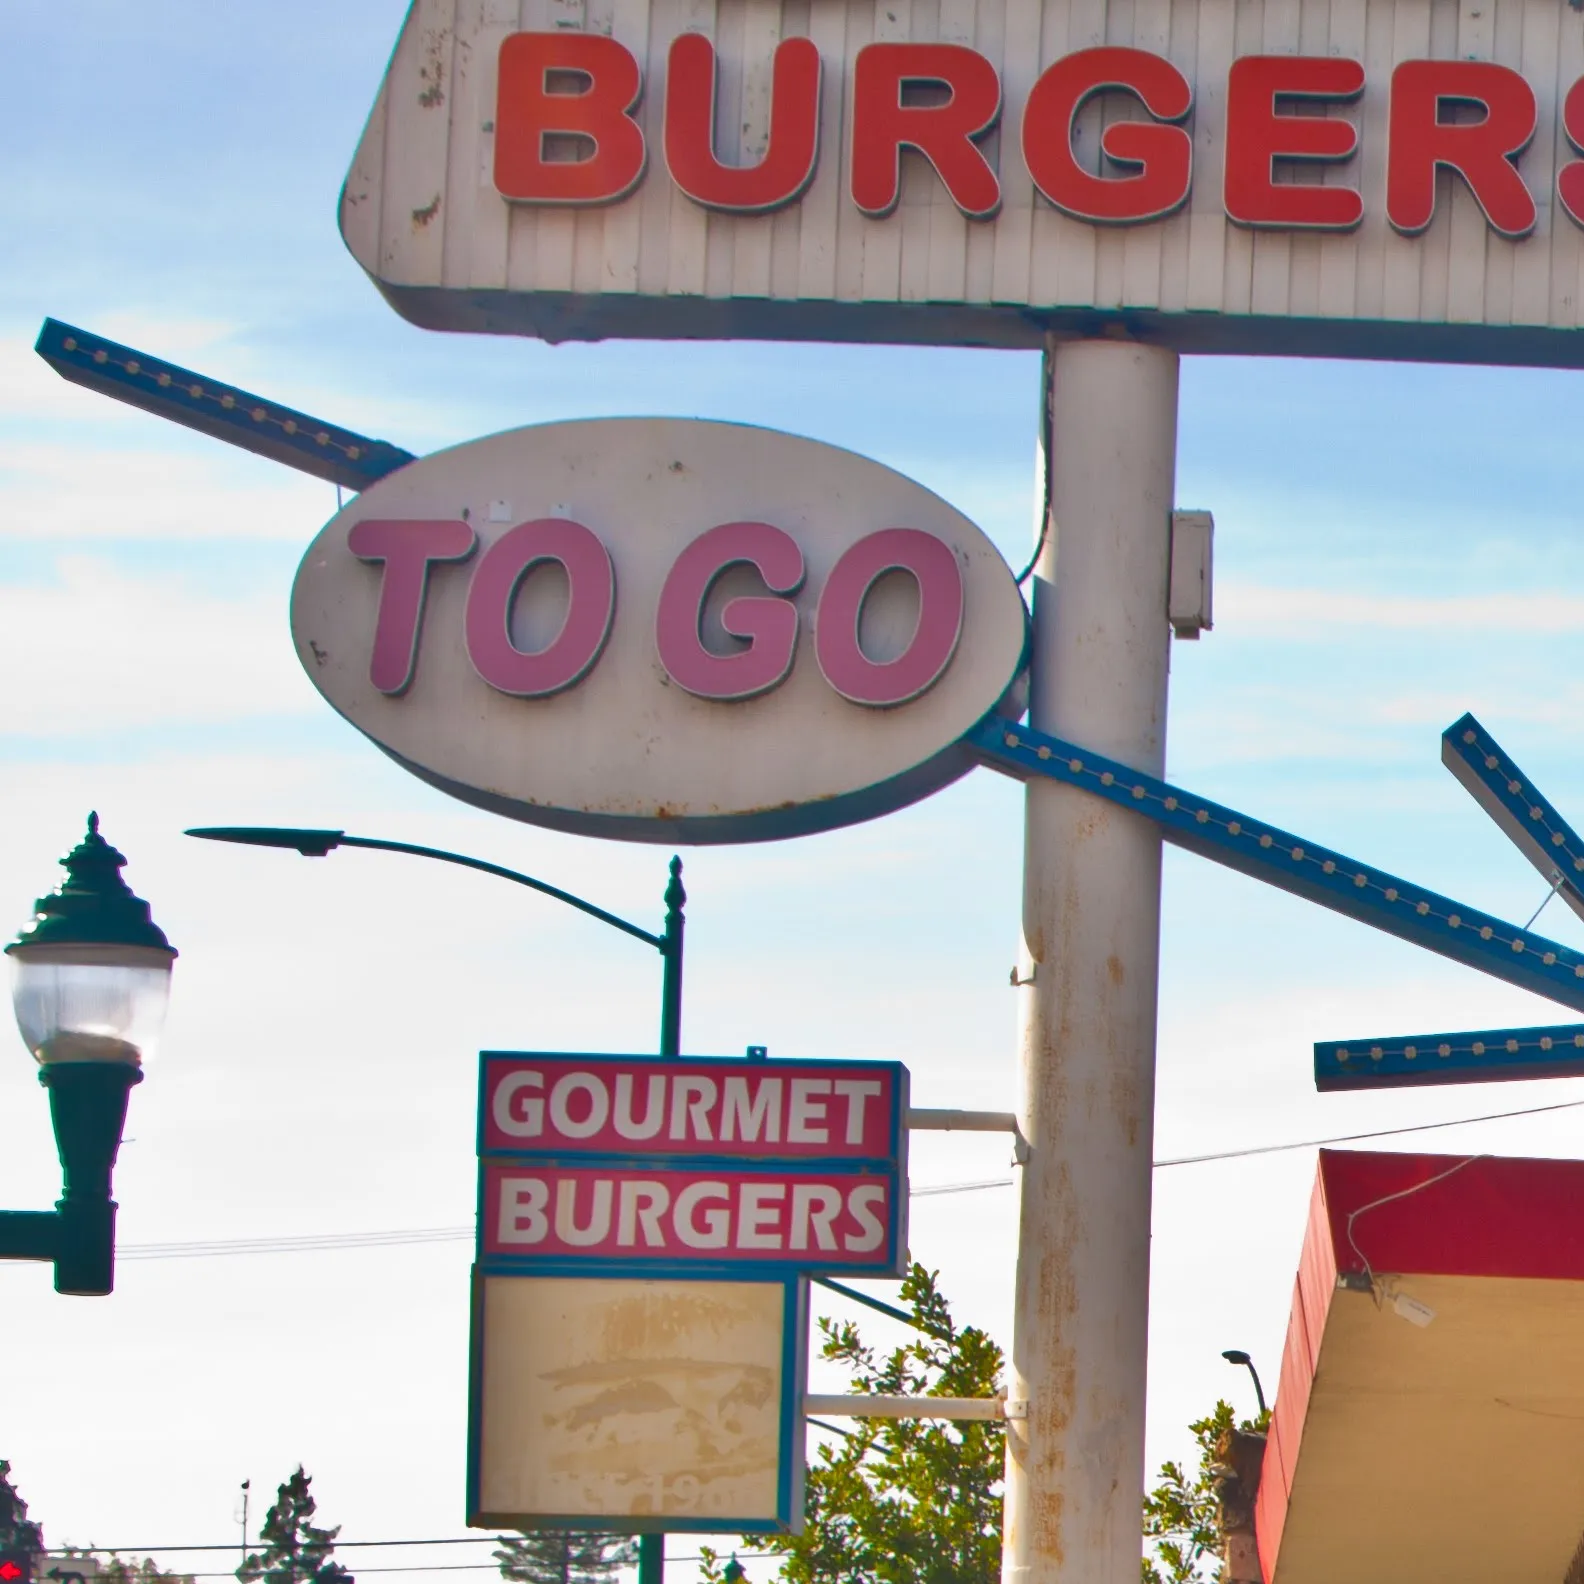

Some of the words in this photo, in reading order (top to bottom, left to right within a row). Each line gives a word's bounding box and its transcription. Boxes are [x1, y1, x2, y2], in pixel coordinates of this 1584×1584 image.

[347, 518, 616, 700] TO
[655, 520, 965, 708] GO
[492, 1069, 882, 1147] GOURMET
[496, 1176, 886, 1254] BURGERS
